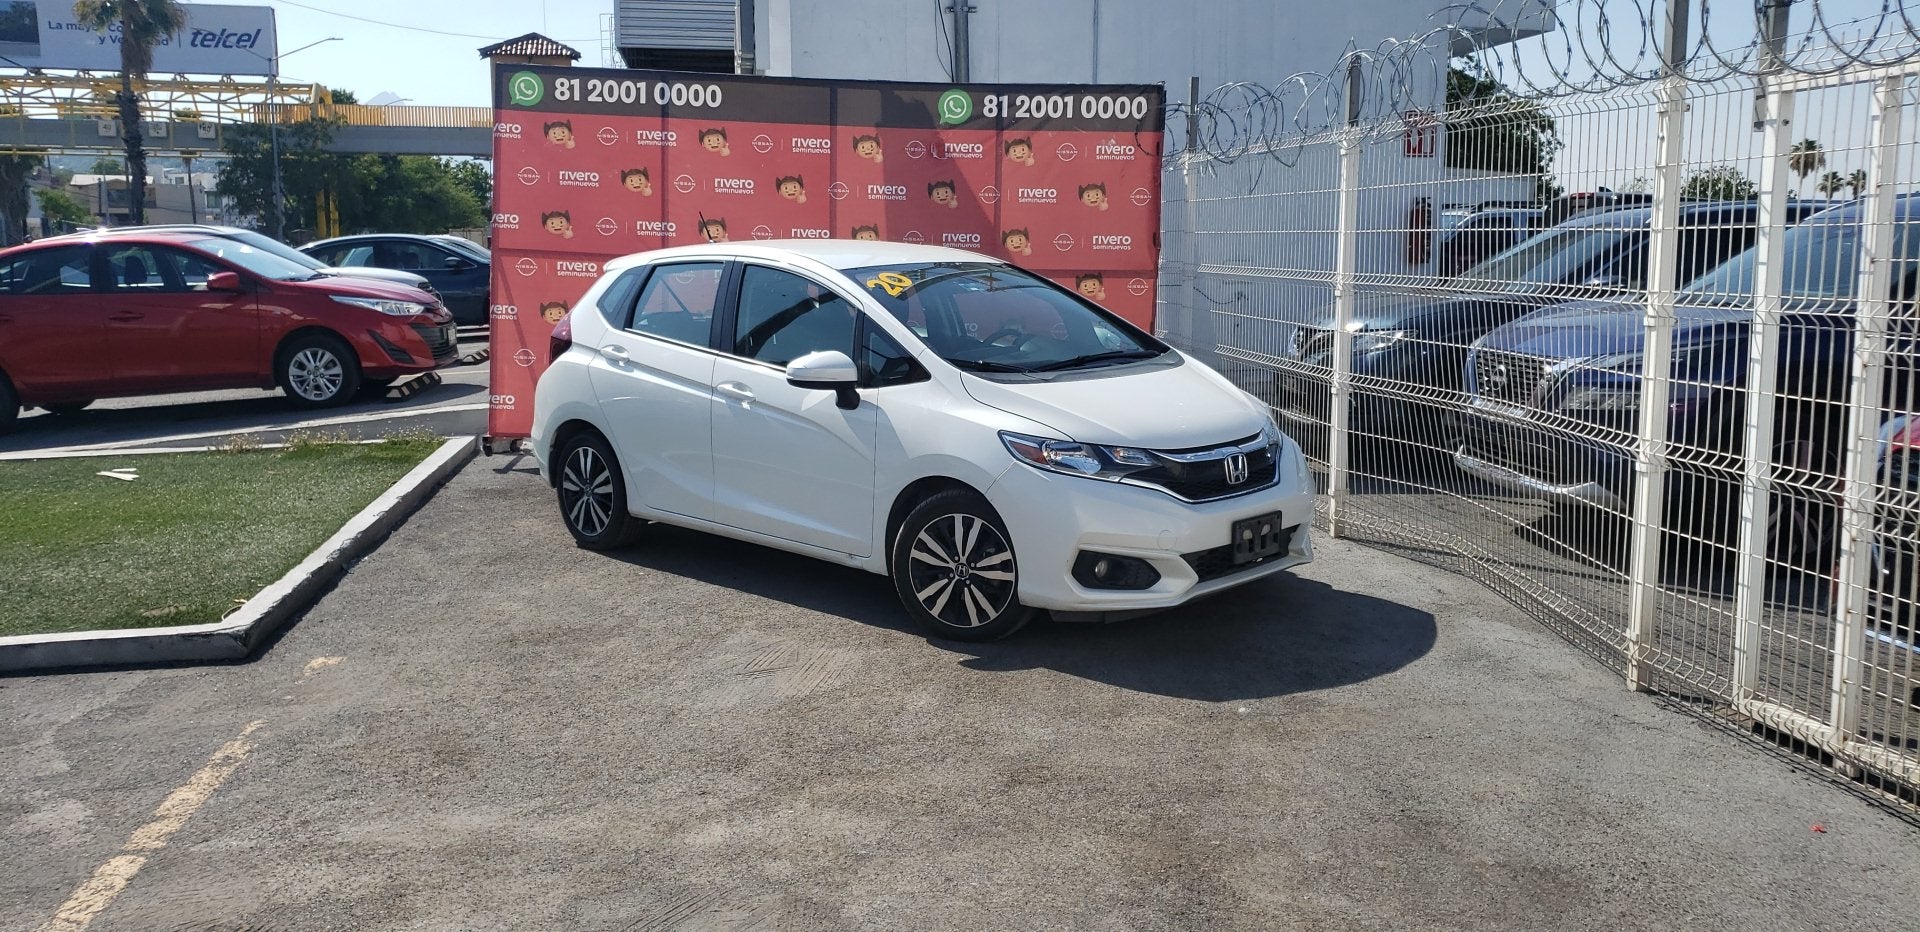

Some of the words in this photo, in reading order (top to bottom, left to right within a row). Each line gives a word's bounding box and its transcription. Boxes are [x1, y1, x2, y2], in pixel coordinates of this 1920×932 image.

[48, 21, 63, 30] La
[99, 36, 106, 45] y
[191, 28, 262, 49] telcel
[555, 78, 580, 102] 81
[587, 79, 646, 105] 2001
[654, 82, 722, 107] 0000
[983, 95, 1008, 118] 81
[1015, 95, 1073, 119] 2001
[1081, 96, 1148, 120] 0000
[637, 130, 676, 142] rivero
[637, 138, 676, 147] seminuevos
[792, 137, 830, 149] rivero
[945, 142, 983, 154] rivero
[792, 145, 830, 154] seminuevos
[945, 150, 983, 159] seminuevos
[1096, 144, 1134, 156] rivero
[1096, 152, 1134, 161] seminuevos
[560, 170, 599, 182] rivero
[560, 179, 599, 188] seminuevos
[715, 178, 754, 190] rivero
[715, 186, 754, 195] seminuevos
[868, 184, 906, 196] rivero
[1019, 187, 1057, 199] rivero
[868, 192, 906, 201] seminuevos
[1019, 195, 1057, 204] seminuevos
[637, 220, 676, 232] rivero
[637, 228, 676, 237] seminuevos
[791, 228, 830, 239] rivero
[942, 233, 981, 243] rivero
[1093, 234, 1131, 246] rivero
[1093, 242, 1131, 251] seminuevos
[557, 261, 597, 273] rivero
[557, 269, 597, 278] seminuevos
[866, 272, 913, 297] 20
